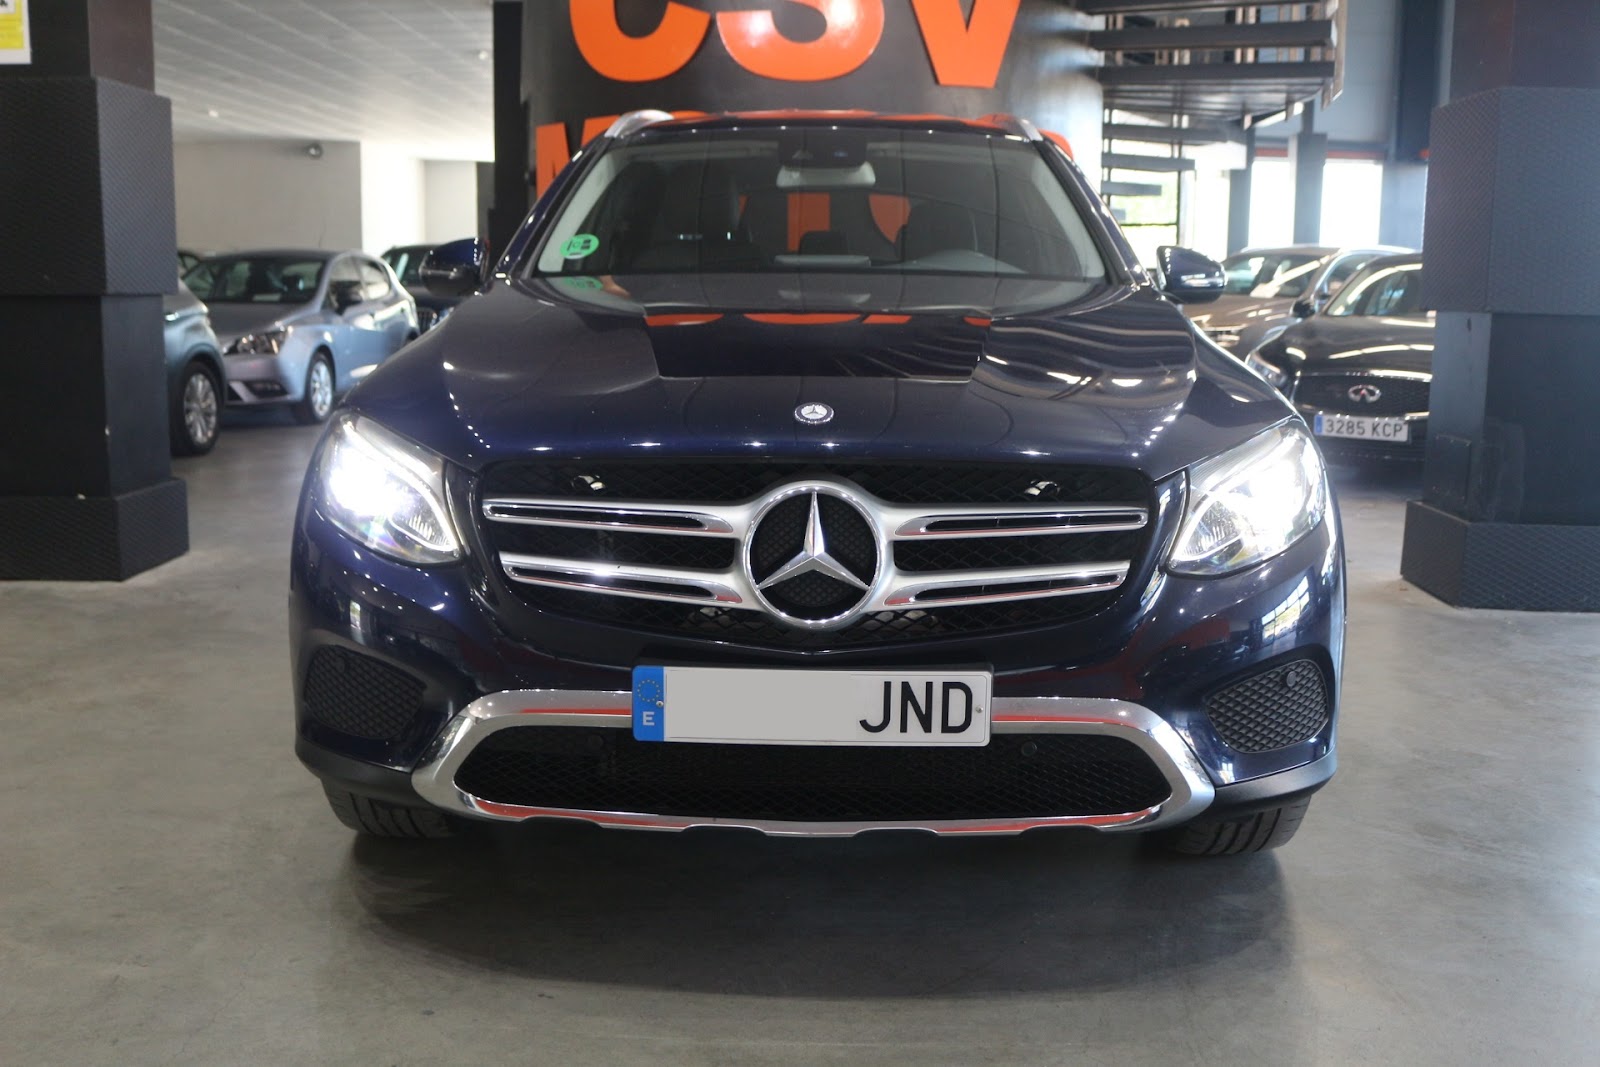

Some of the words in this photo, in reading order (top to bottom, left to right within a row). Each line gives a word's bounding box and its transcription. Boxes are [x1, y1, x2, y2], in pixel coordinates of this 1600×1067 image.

[1325, 418, 1366, 436] 3285
[1371, 421, 1403, 438] KCP
[859, 681, 973, 734] JND
[642, 711, 655, 726] E
